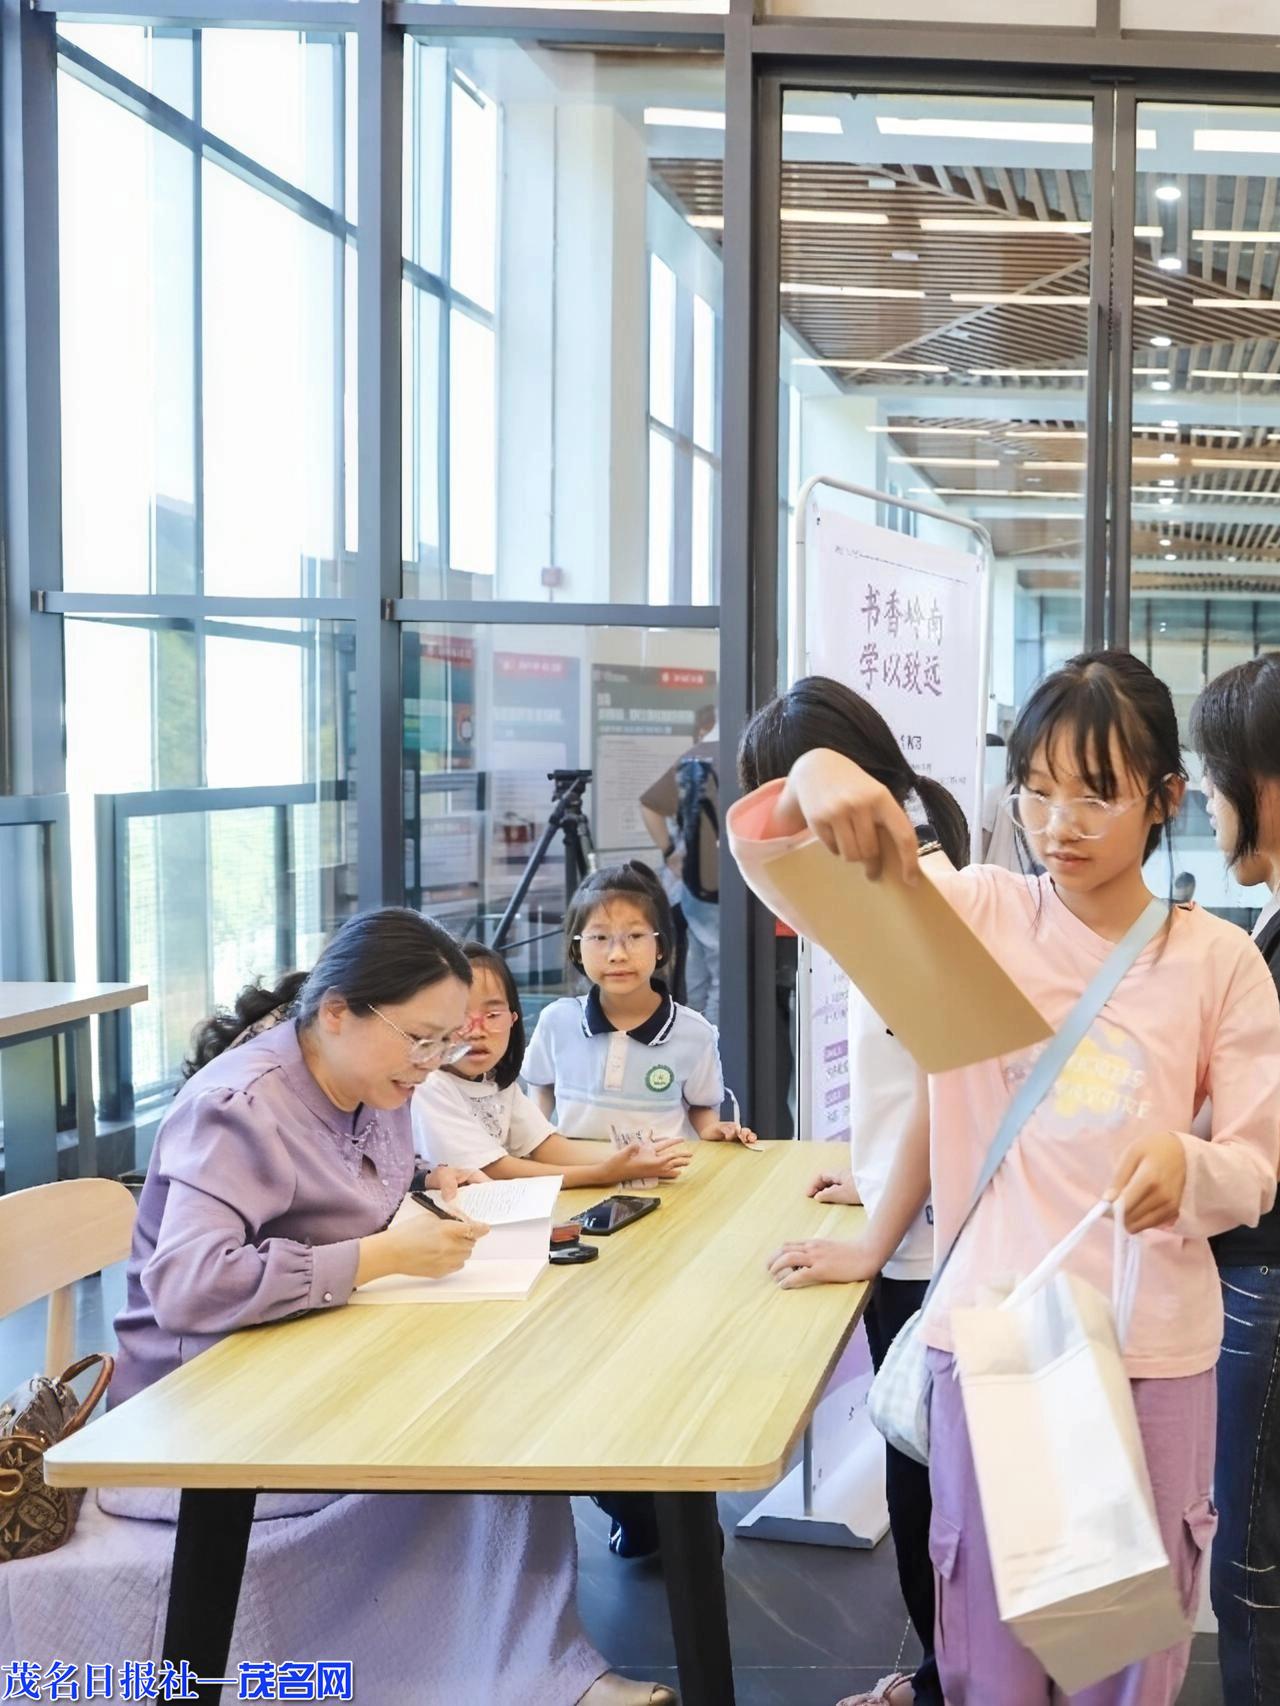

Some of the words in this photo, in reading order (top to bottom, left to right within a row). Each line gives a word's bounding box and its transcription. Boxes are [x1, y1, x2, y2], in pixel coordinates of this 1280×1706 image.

[861, 583, 944, 646] 书香岭南
[859, 643, 943, 697] 学以致远
